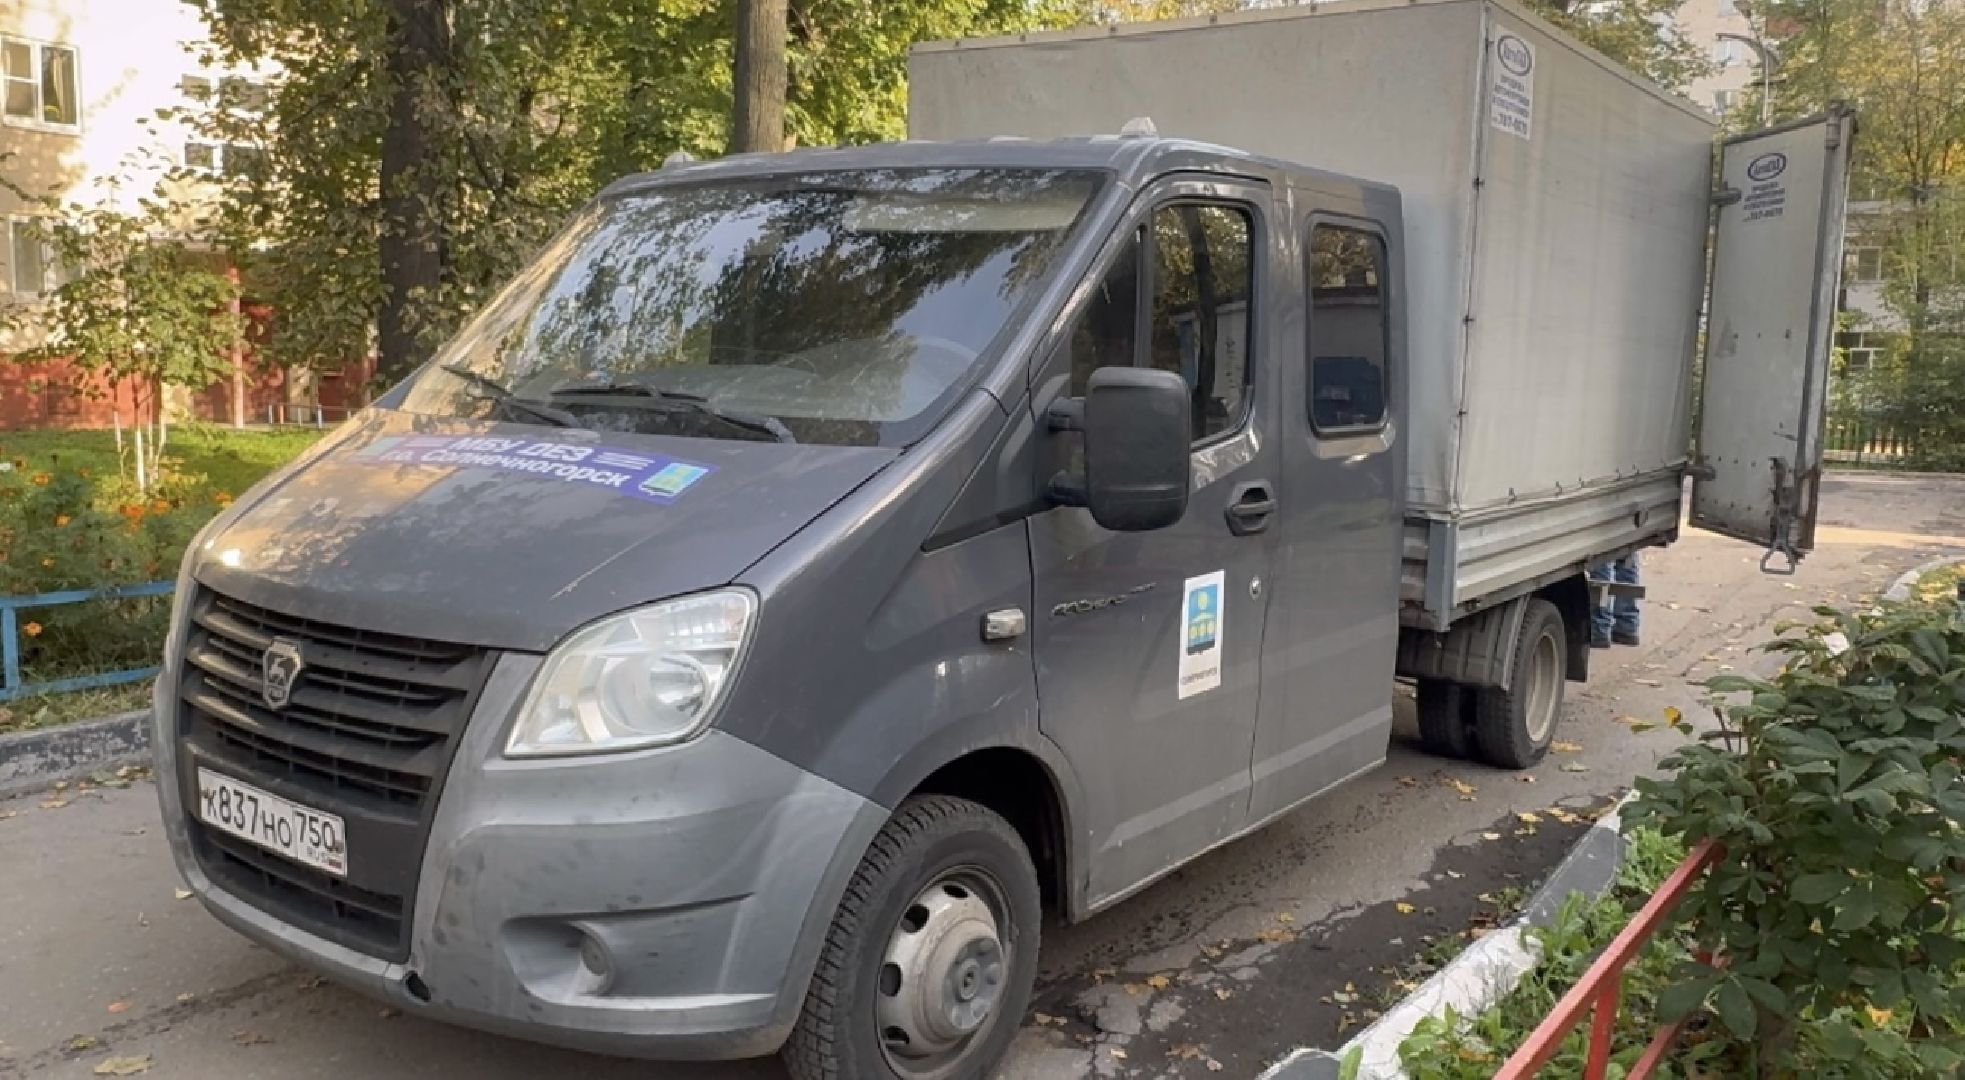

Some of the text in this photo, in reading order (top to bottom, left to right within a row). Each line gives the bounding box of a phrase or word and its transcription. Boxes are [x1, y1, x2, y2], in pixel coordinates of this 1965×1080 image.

[420, 449, 631, 488] Солнечногорск
[448, 437, 594, 462] МБУ ДЕЗ
[295, 810, 337, 852] 750
